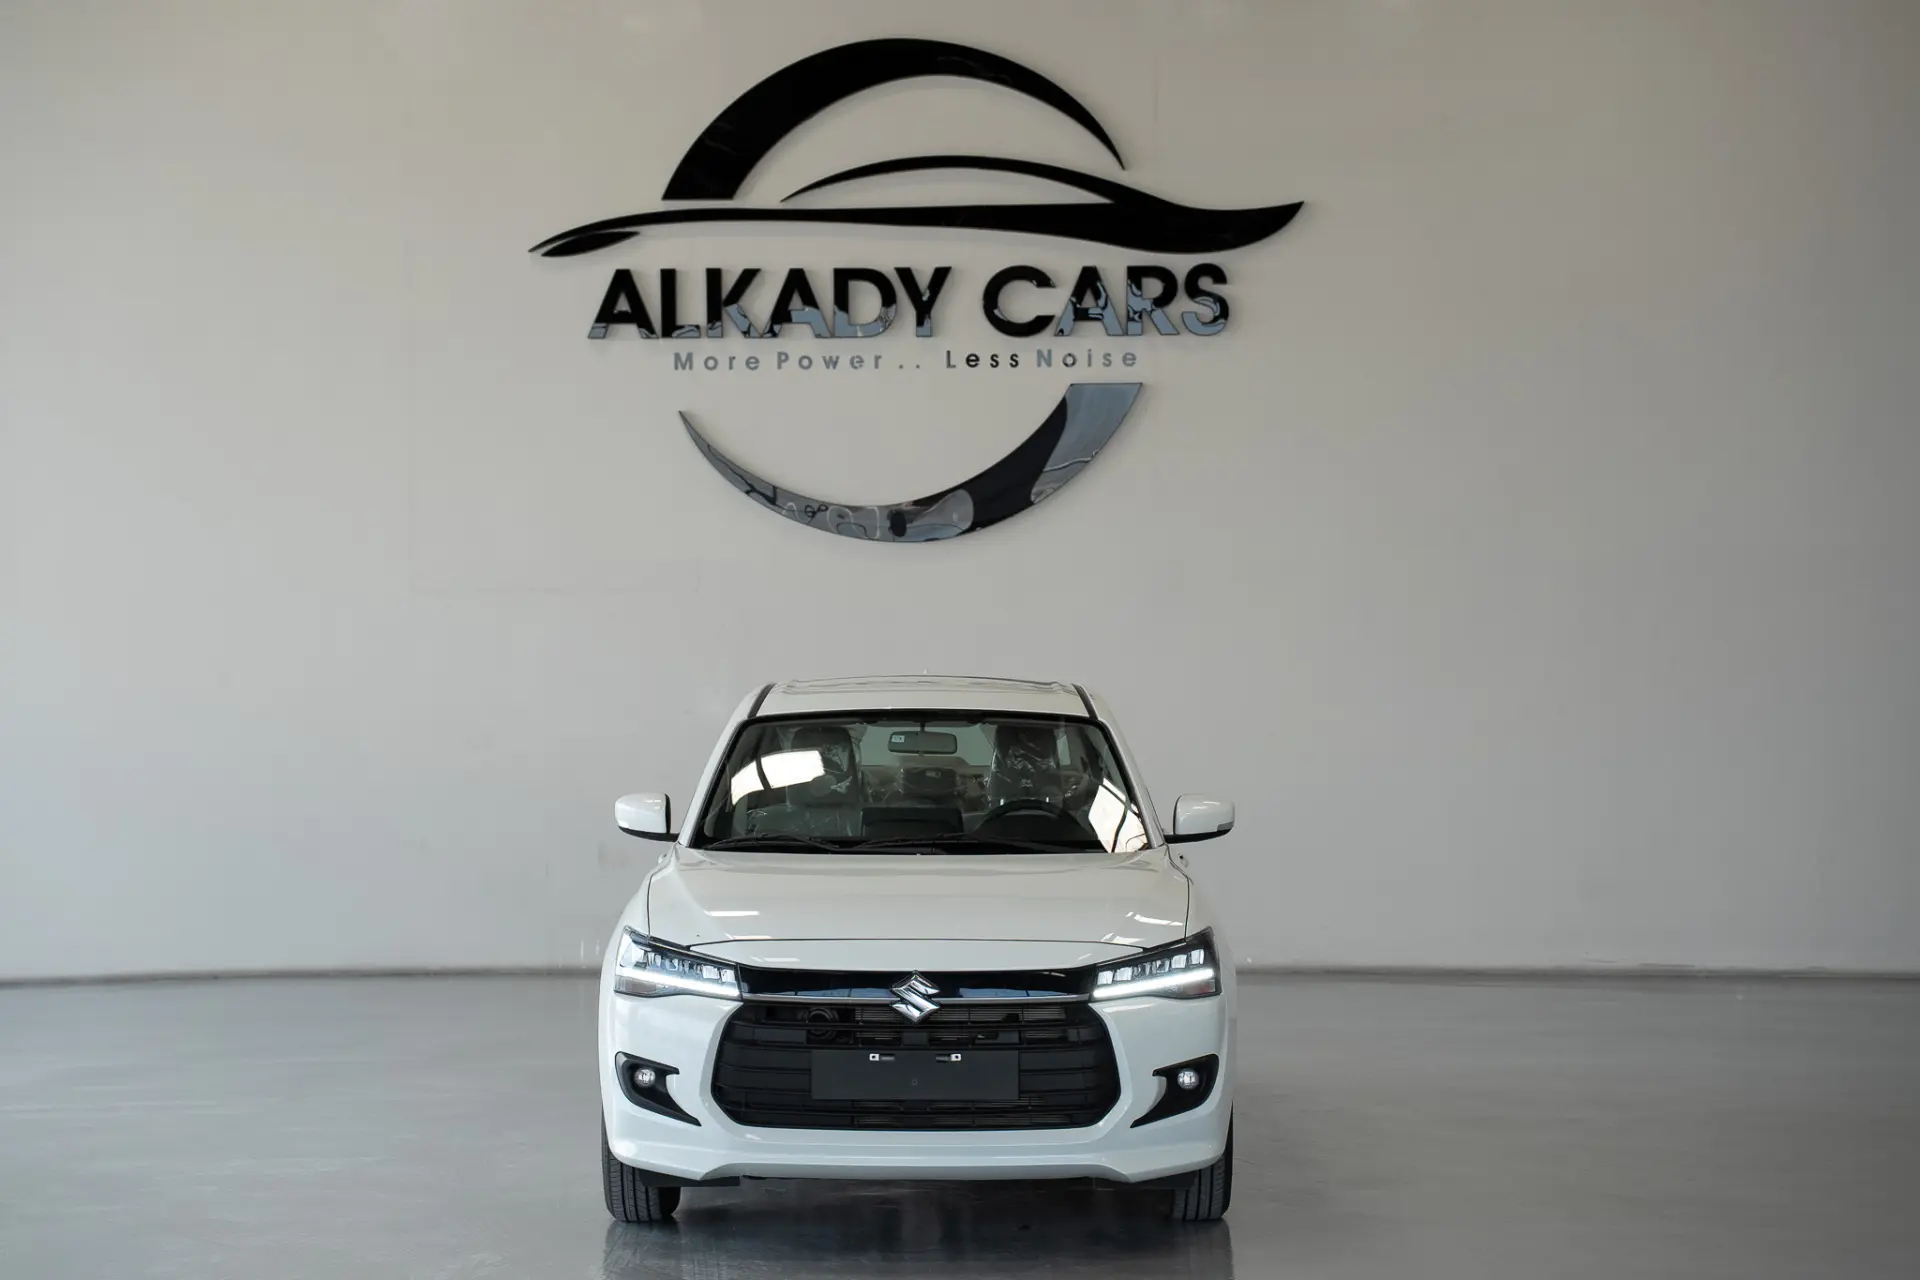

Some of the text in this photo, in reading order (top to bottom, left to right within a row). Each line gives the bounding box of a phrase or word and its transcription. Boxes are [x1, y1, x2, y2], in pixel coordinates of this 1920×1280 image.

[587, 262, 1231, 340] ALKADY CARS
[673, 352, 760, 371] More
[946, 350, 1020, 369] Less
[1036, 349, 1137, 368] Noise
